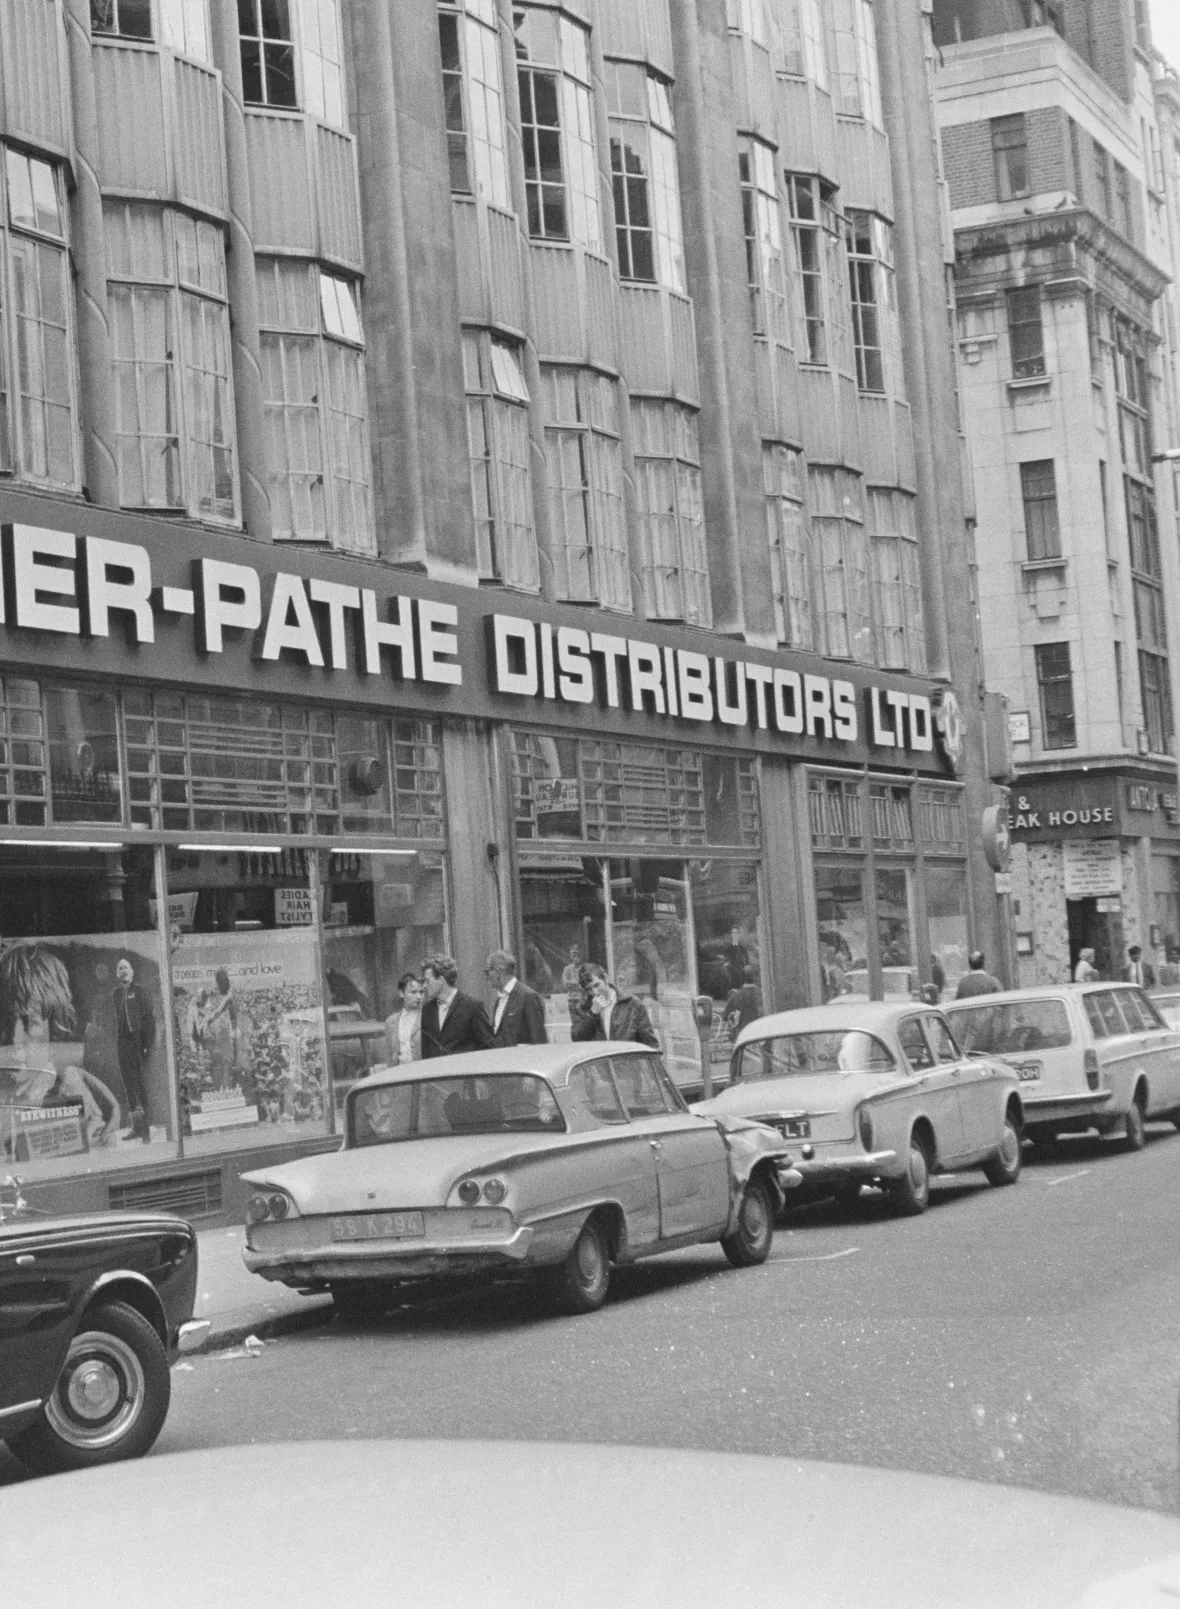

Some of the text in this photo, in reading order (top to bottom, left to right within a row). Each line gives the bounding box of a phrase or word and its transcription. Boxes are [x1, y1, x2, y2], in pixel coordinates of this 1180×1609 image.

[492, 613, 859, 742] DISTRIBUTORS
[869, 686, 933, 752] LTD
[1017, 795, 1031, 811] &
[1048, 806, 1114, 827] HOUSE
[260, 960, 282, 975] love
